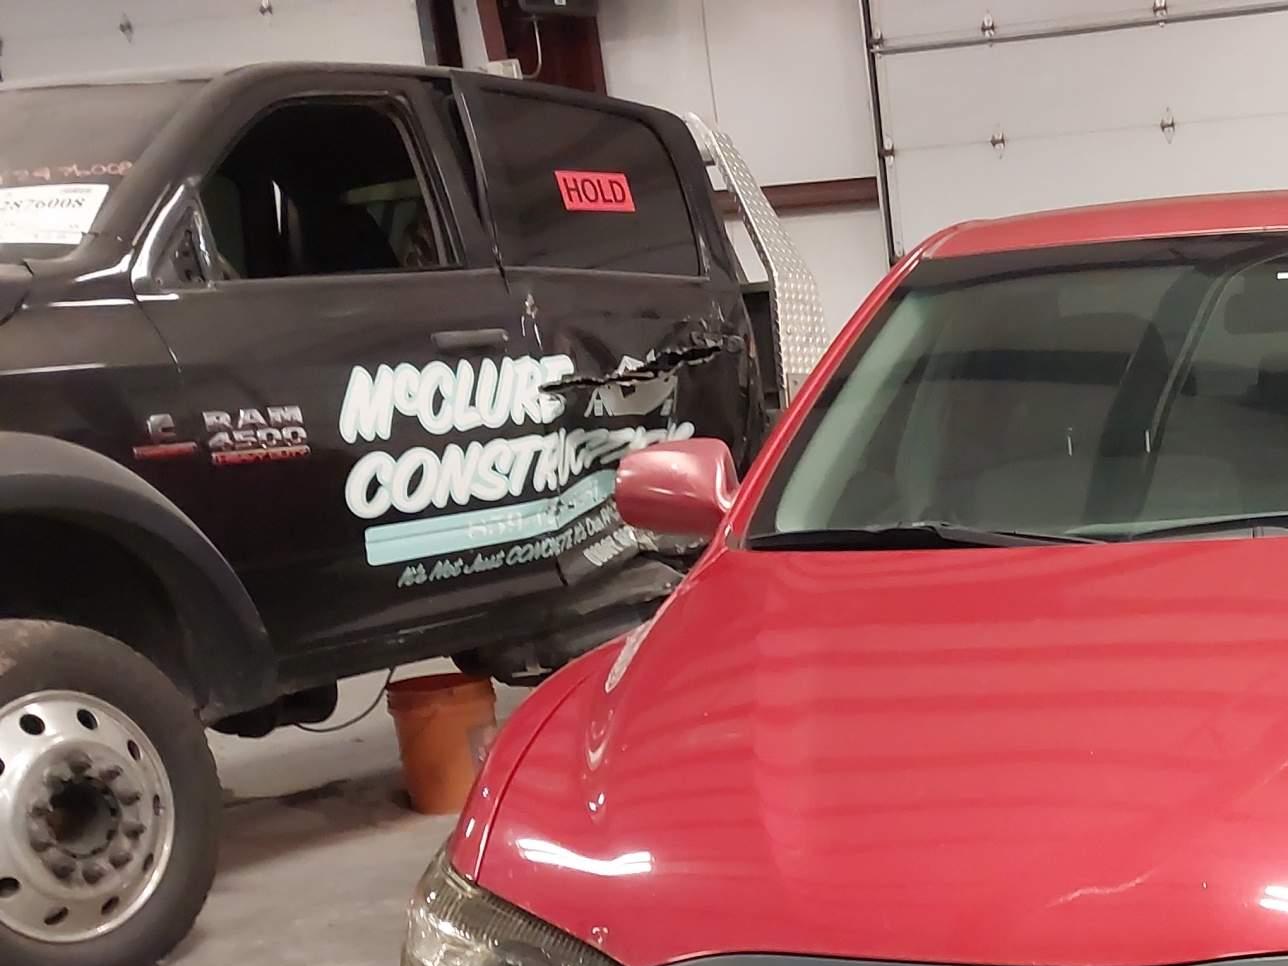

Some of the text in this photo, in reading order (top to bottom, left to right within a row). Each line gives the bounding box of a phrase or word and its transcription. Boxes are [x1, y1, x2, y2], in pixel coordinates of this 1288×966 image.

[562, 177, 627, 203] HOLD
[202, 406, 304, 431] RAM
[208, 426, 308, 450] 4500
